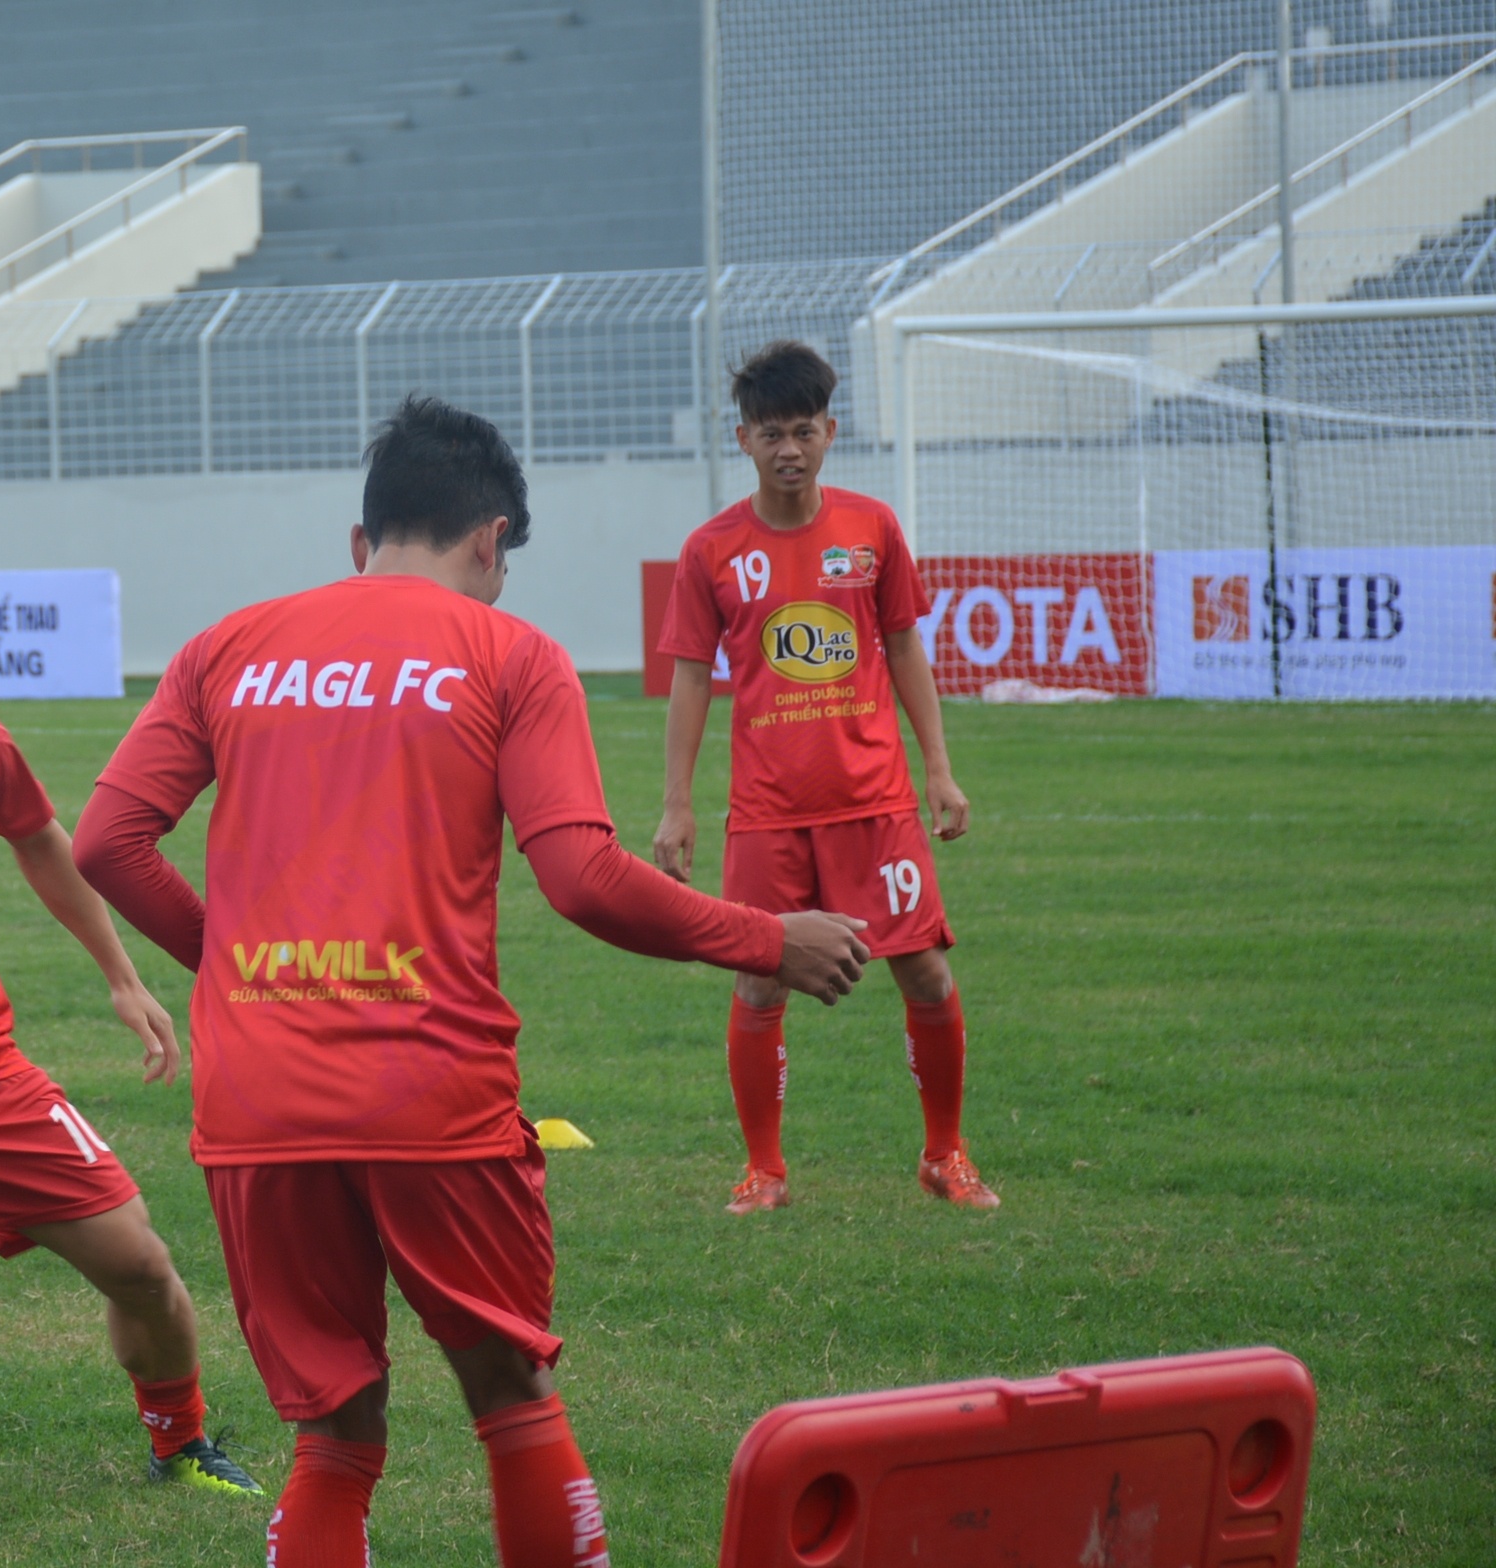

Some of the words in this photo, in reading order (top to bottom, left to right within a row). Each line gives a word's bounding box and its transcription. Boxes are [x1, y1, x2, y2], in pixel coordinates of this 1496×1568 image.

[729, 550, 771, 603] 19
[15, 604, 58, 631] THAO
[916, 585, 1123, 665] YOTA
[1262, 573, 1403, 642] SHB
[772, 623, 827, 665] IQ
[817, 629, 852, 647] Lac
[824, 647, 855, 663] Pro
[231, 660, 375, 708] HAGL
[390, 659, 468, 712] FC
[879, 859, 921, 916] 19
[233, 940, 424, 985] VPMILK
